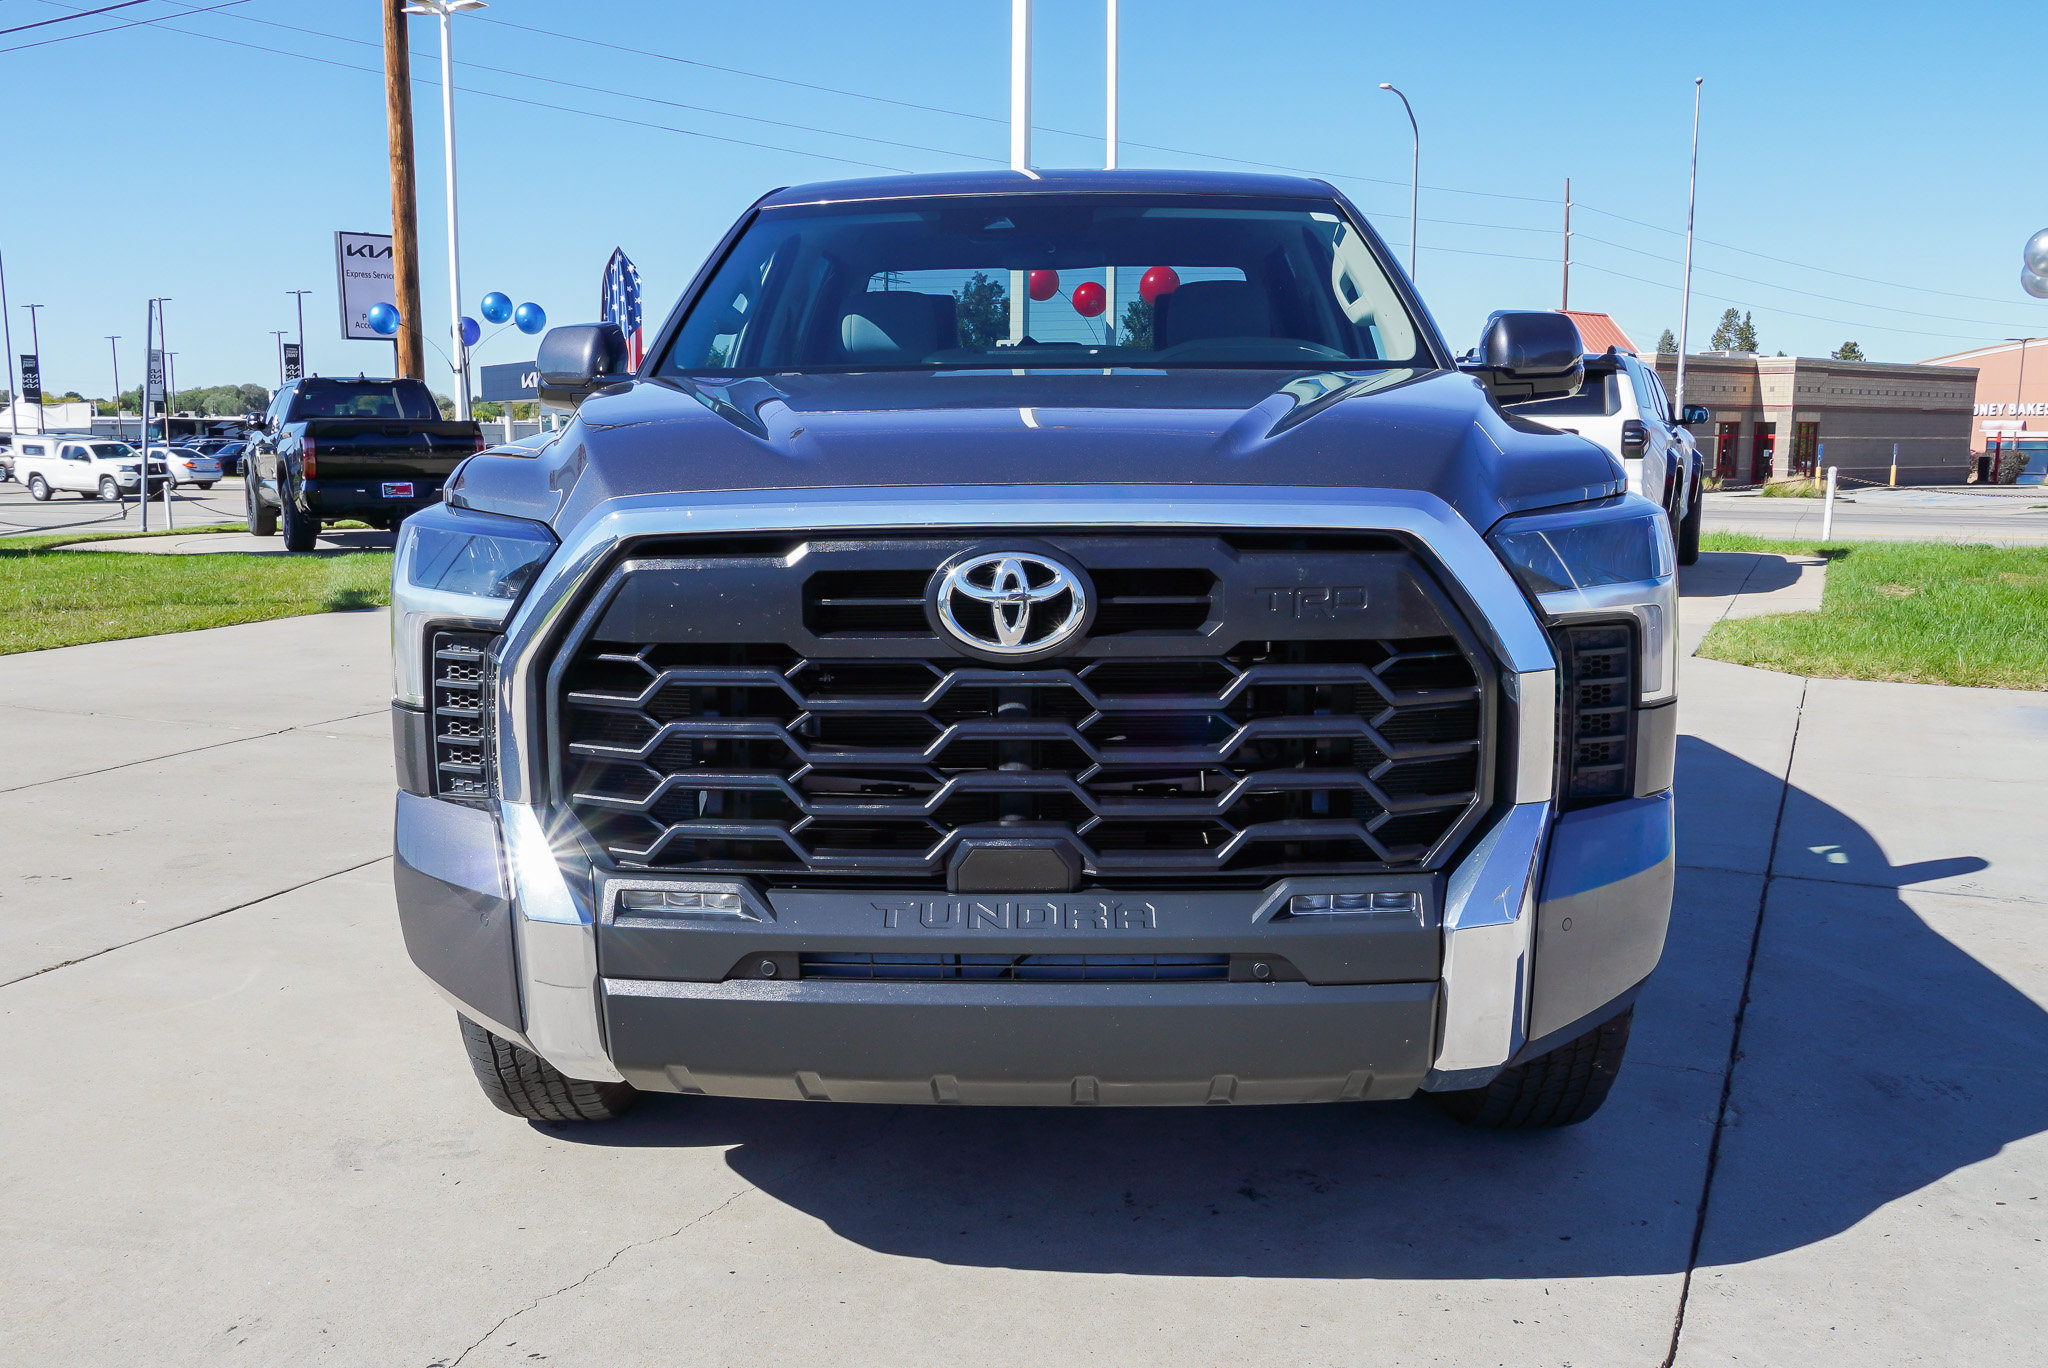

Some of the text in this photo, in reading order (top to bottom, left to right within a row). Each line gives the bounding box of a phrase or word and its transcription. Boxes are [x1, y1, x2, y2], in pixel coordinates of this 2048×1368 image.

[346, 243, 393, 259] KIA
[346, 269, 372, 280] Express
[521, 371, 538, 389] KI
[1973, 403, 2006, 416] ONEY
[1254, 586, 1368, 619] TRD
[870, 901, 1157, 930] TUNDRA
